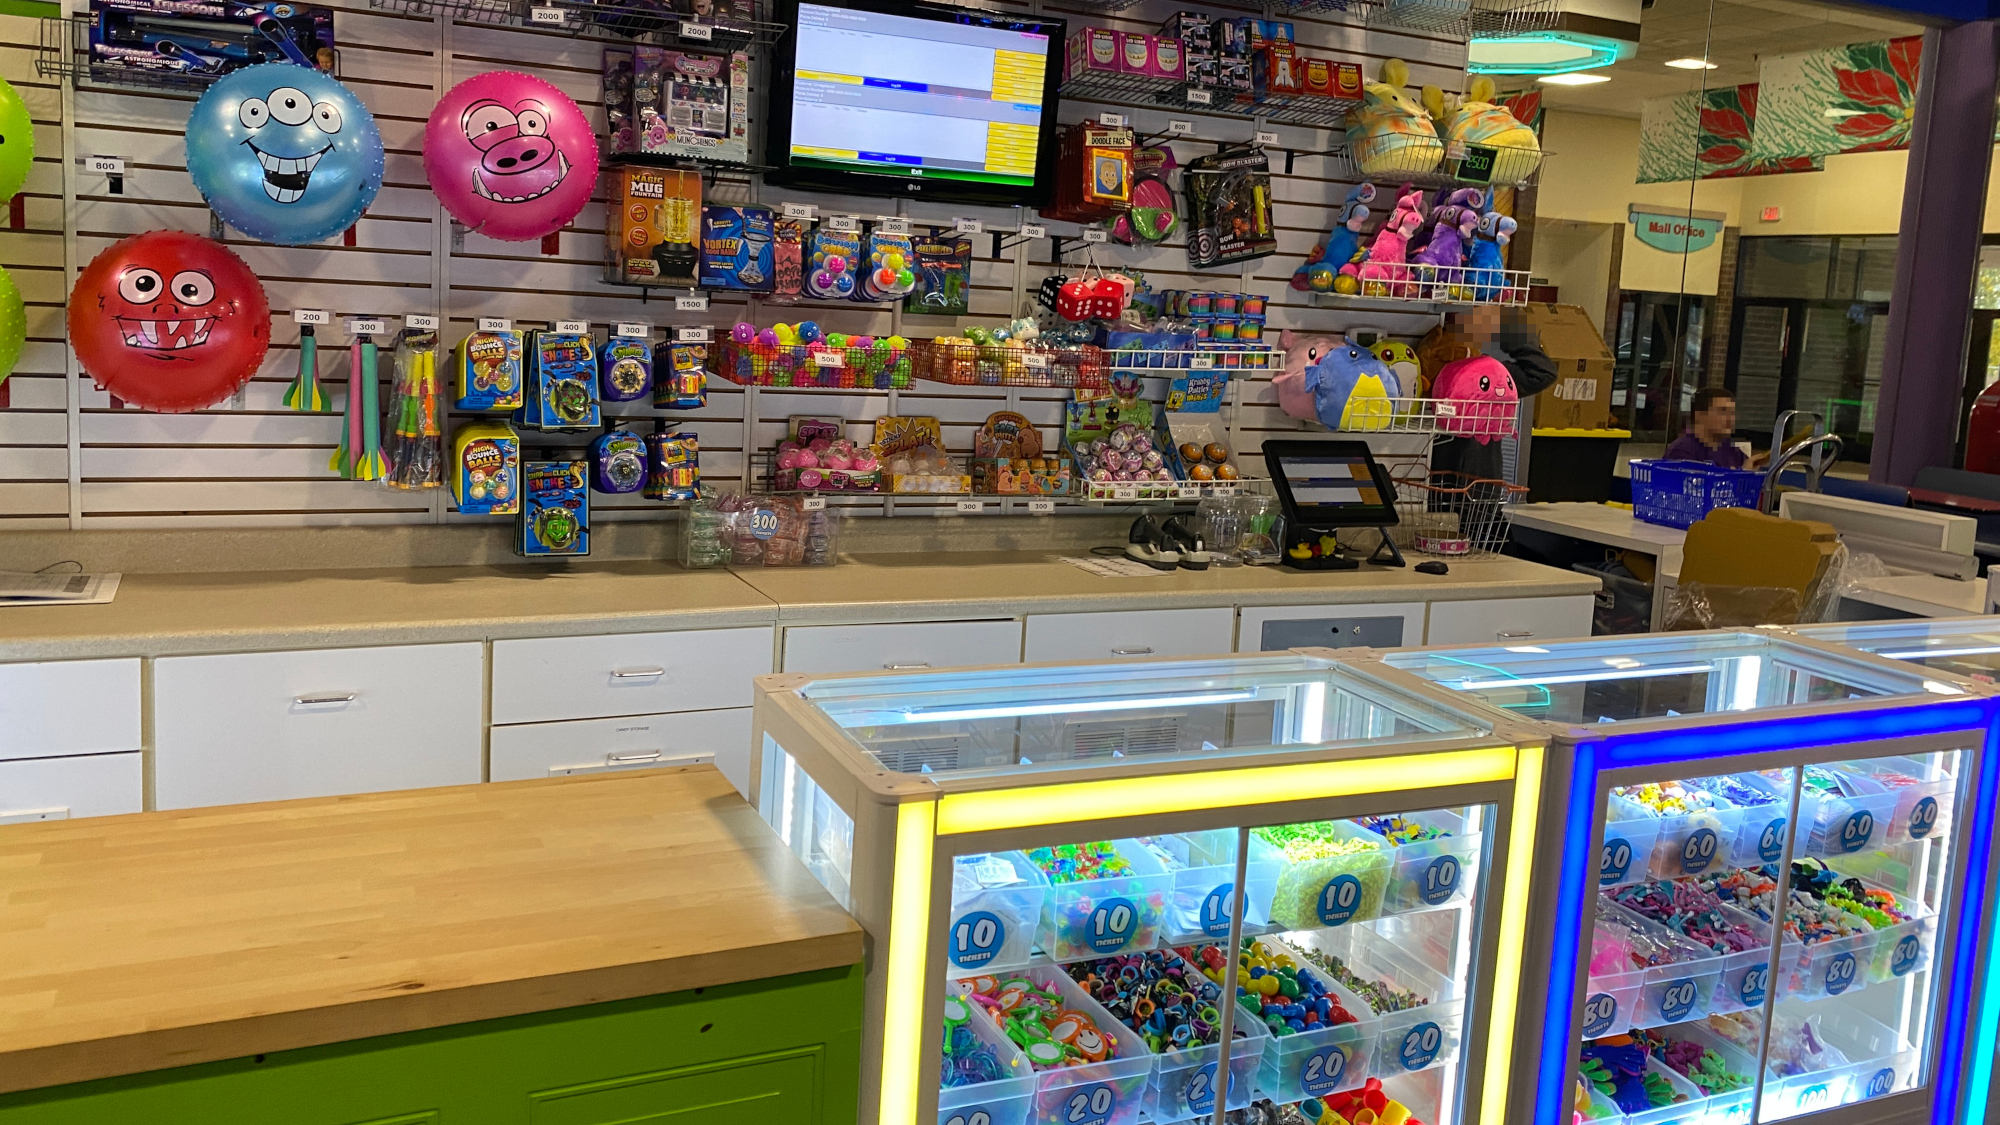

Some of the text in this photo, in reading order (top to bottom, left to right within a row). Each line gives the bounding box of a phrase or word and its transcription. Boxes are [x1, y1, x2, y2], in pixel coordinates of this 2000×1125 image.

[152, 0, 225, 16] TELESCOPE
[537, 12, 559, 21] 2000
[687, 27, 707, 37] 2000
[124, 56, 180, 66] ASTRONOMIQUE
[676, 136, 716, 148] MUNCHLINGS
[1092, 137, 1112, 145] DOODLE
[95, 162, 115, 171] 800
[1237, 157, 1264, 167] BLASTER
[631, 175, 663, 184] MAGIC
[630, 181, 663, 193] MUG
[1026, 228, 1039, 236] 300
[1649, 222, 1671, 234] Mall
[1088, 232, 1101, 240] 300
[1219, 233, 1234, 243] BOW
[703, 239, 737, 249] VORTEX
[1220, 242, 1245, 251] BLASTER
[303, 313, 320, 321] 200
[414, 318, 431, 326] 300
[487, 321, 503, 329] 300
[470, 341, 503, 352] BOUNCE
[476, 337, 494, 345] HIGH
[541, 342, 556, 351] SNAP
[472, 348, 505, 360] BALLS
[542, 348, 582, 363] SNAKES
[821, 356, 835, 364] 500
[1027, 356, 1041, 364] 500
[800, 426, 837, 437] SPLAT
[995, 432, 1016, 441] PUTTY
[881, 433, 901, 445] STICKY
[466, 449, 500, 461] BOUNCE
[472, 445, 491, 453] HIGH
[468, 455, 501, 469] BALLS
[528, 471, 543, 480] SNAP
[552, 469, 570, 477] CLICK
[529, 476, 572, 492] SNAKES
[1035, 502, 1048, 510] 300
[752, 514, 778, 530] 300
[1911, 803, 1937, 826] 60
[1844, 814, 1872, 840] 60
[1761, 823, 1786, 849] 60
[1684, 833, 1715, 860] 60
[1601, 844, 1630, 870] 60
[1426, 861, 1456, 885] 10
[1325, 881, 1357, 911] 10
[1428, 889, 1451, 900] TICKETS
[1208, 890, 1234, 921] 10
[1094, 904, 1132, 937] 10
[1325, 910, 1350, 921] TICKETS
[956, 917, 997, 952] 10
[1095, 937, 1124, 947] TICKETS
[958, 951, 991, 964] TICKETS
[1892, 940, 1919, 966] 80
[1826, 958, 1854, 983] 80
[1742, 968, 1768, 994] 80
[1662, 982, 1695, 1011] 80
[1583, 997, 1614, 1027] 80
[1667, 1007, 1688, 1018] TICKETS
[1587, 1021, 1610, 1035] TICKETS
[1403, 1026, 1440, 1058] 20
[1407, 1054, 1431, 1066] TICKETS
[1304, 1052, 1344, 1082] 20
[1308, 1080, 1335, 1092] TICKETS
[1869, 1072, 1894, 1095] 100
[1068, 1087, 1113, 1123] 20
